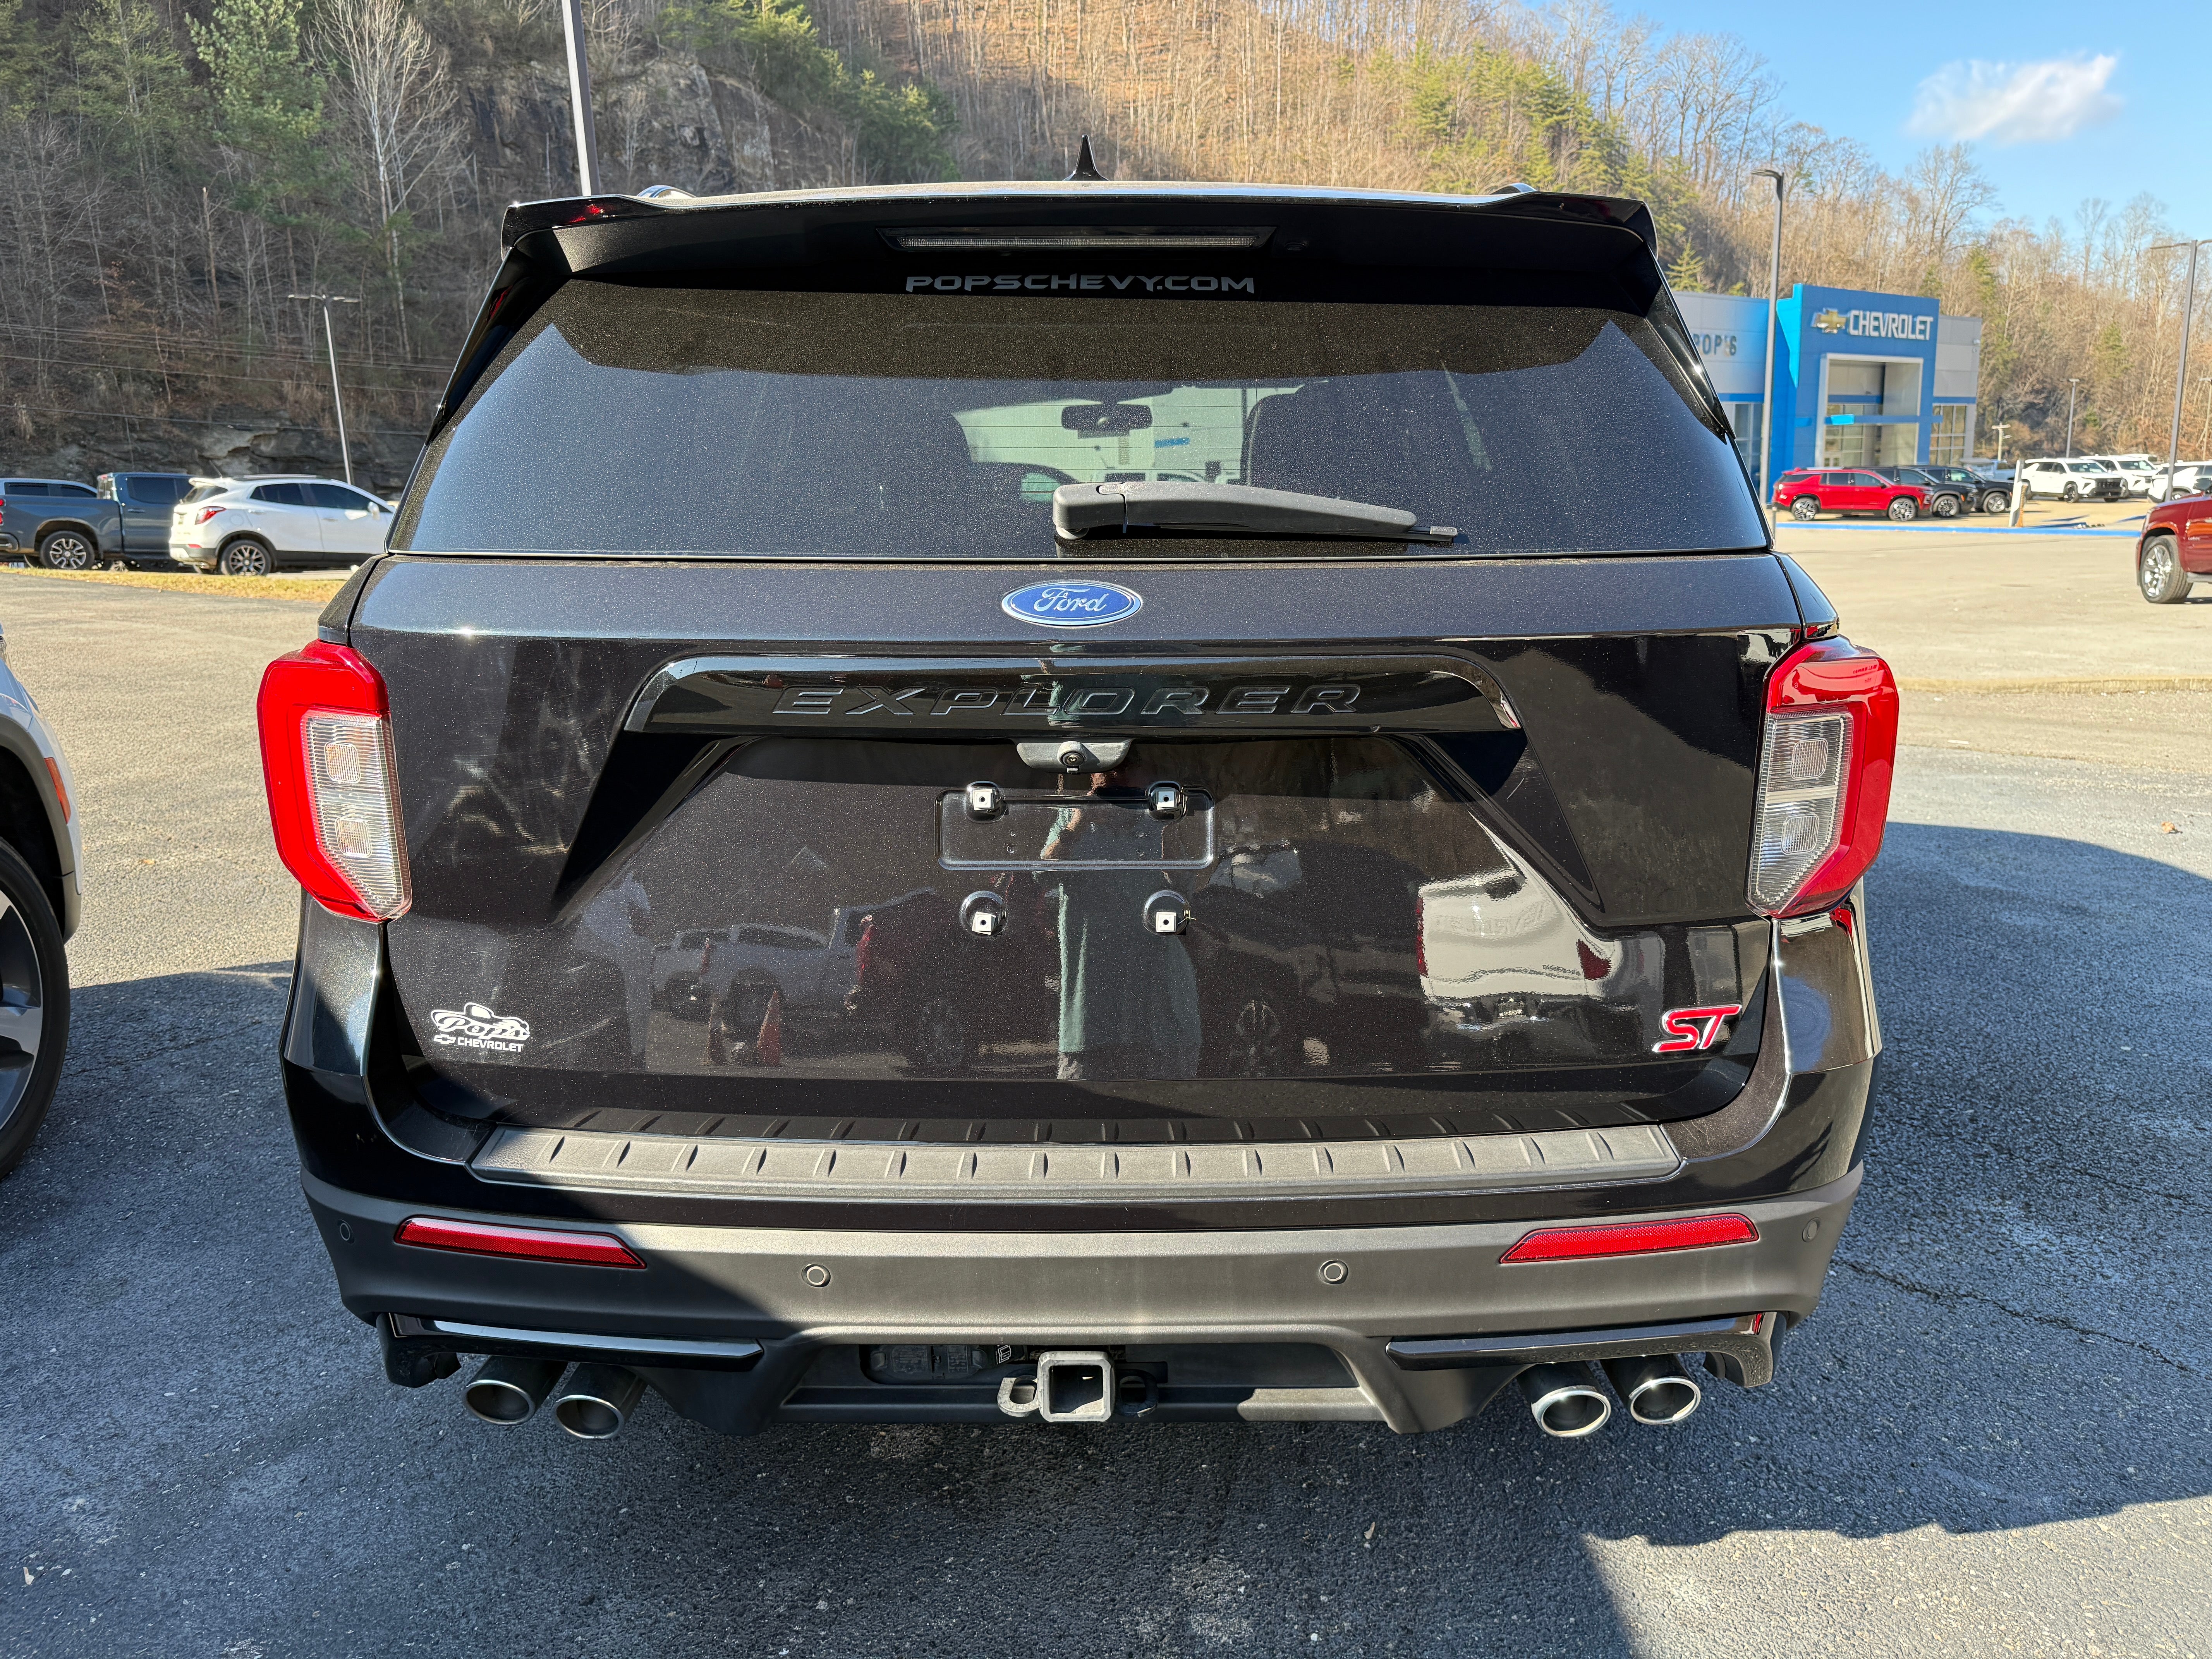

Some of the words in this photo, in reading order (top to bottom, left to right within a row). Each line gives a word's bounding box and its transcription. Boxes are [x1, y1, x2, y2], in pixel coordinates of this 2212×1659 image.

[905, 273, 1255, 294] POPSCHEVY.COM
[1848, 310, 1934, 340] CHEVROLET
[1033, 587, 1109, 612] Ford
[771, 684, 1361, 716] EXPLORER
[1652, 1004, 1742, 1053] ST
[457, 1037, 524, 1052] CHEVROLET
